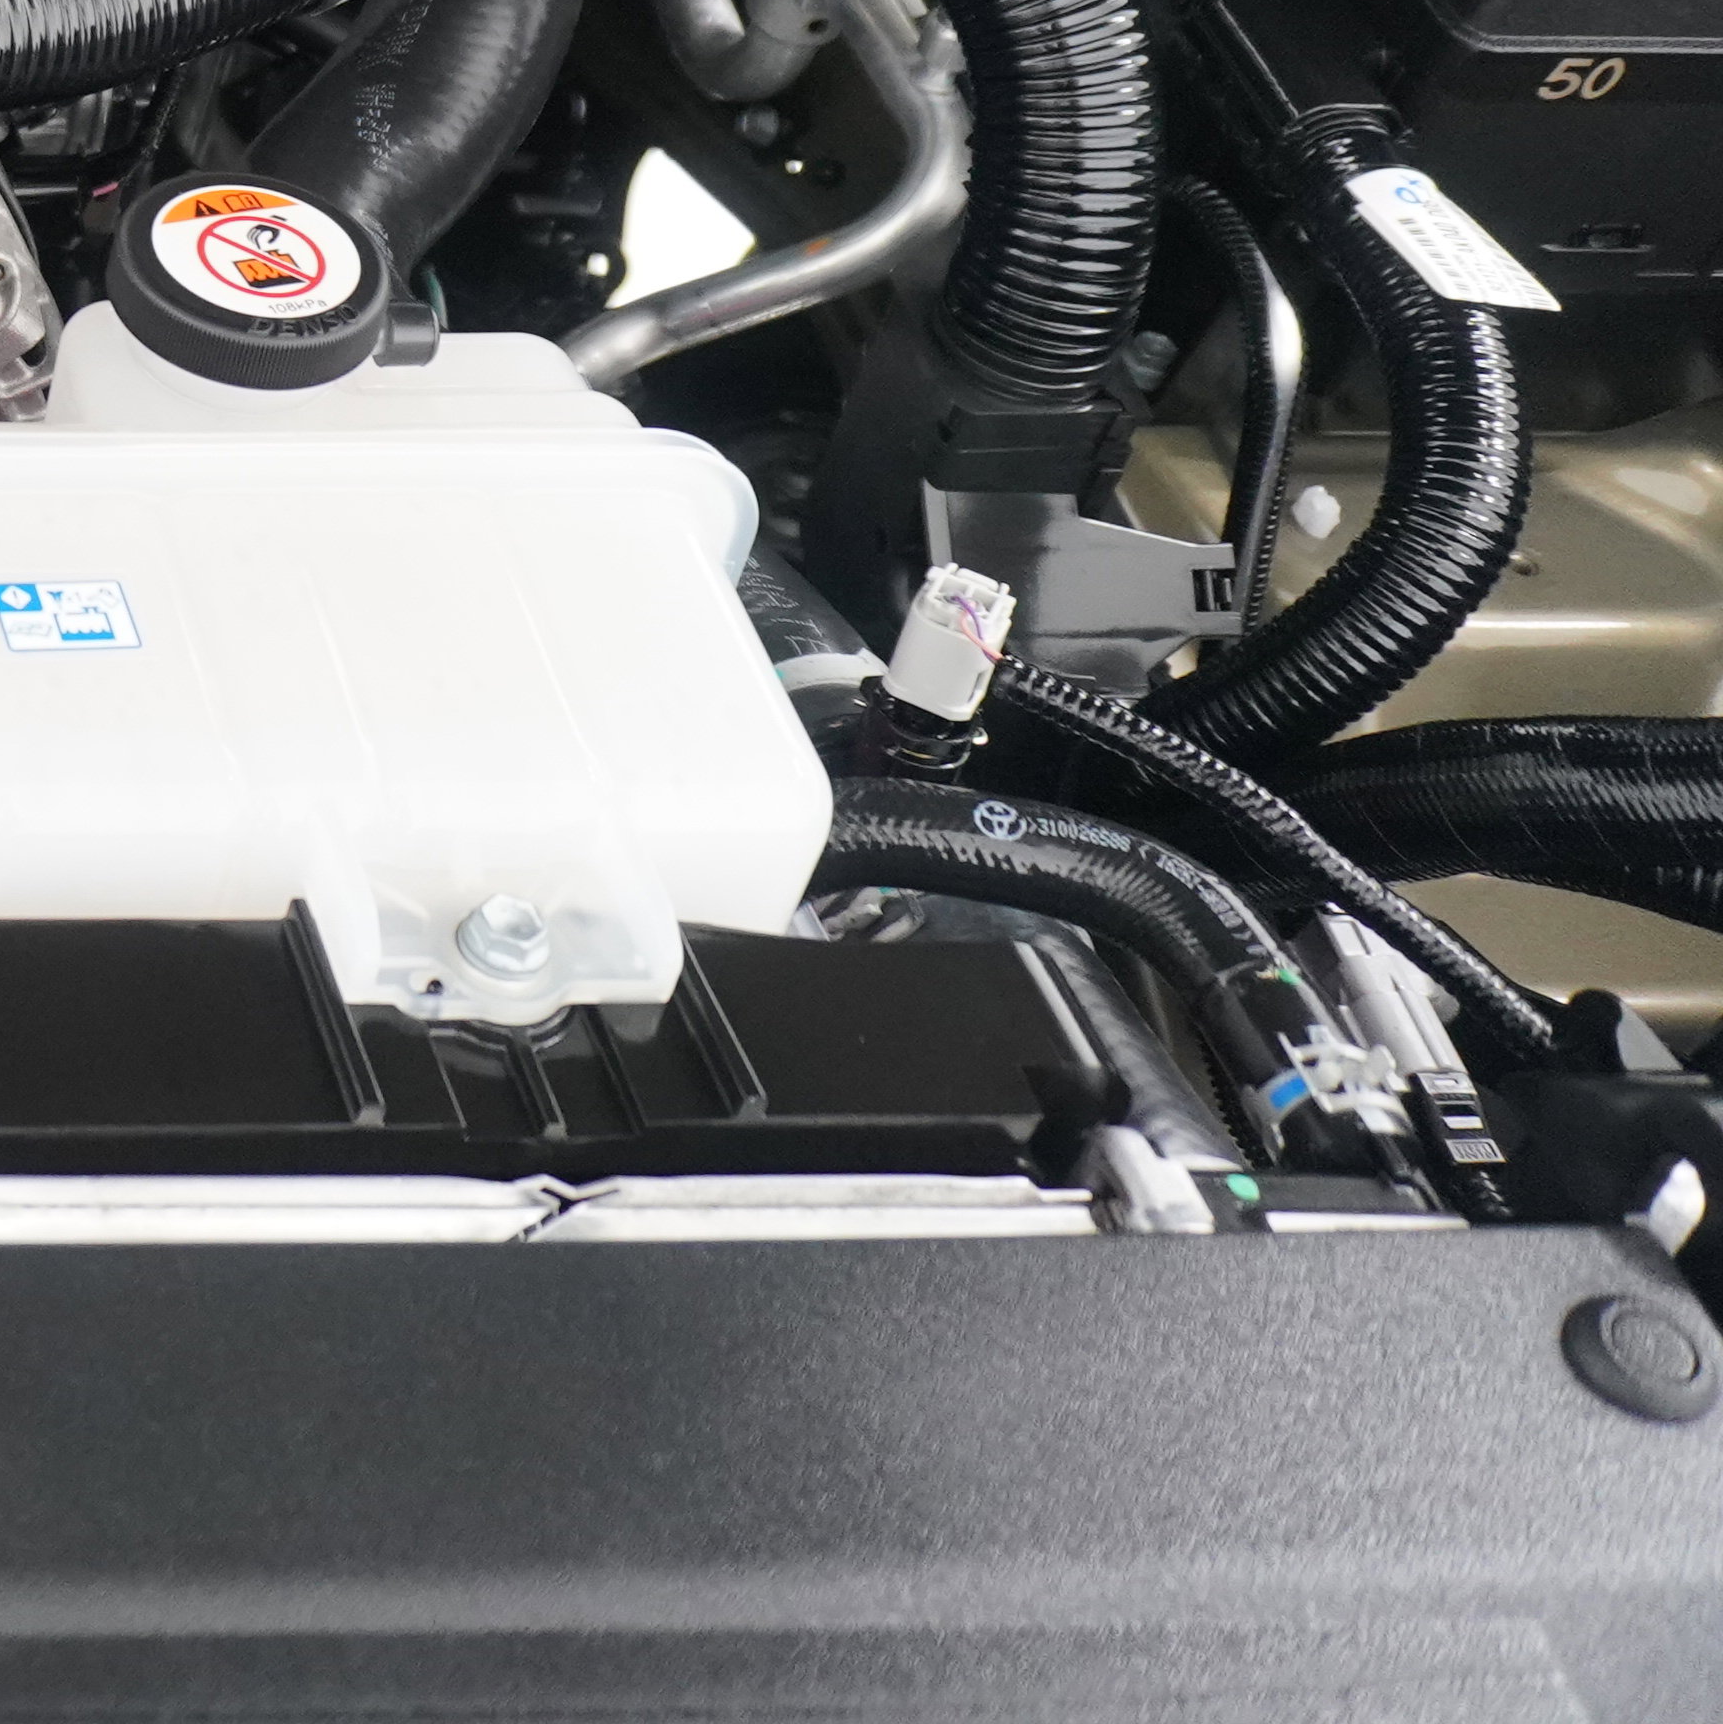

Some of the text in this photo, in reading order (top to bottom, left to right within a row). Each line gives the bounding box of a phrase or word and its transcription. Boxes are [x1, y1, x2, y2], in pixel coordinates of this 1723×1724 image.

[1536, 57, 1626, 100] 50
[249, 305, 357, 337] DENSO
[268, 298, 328, 316] 108kPa
